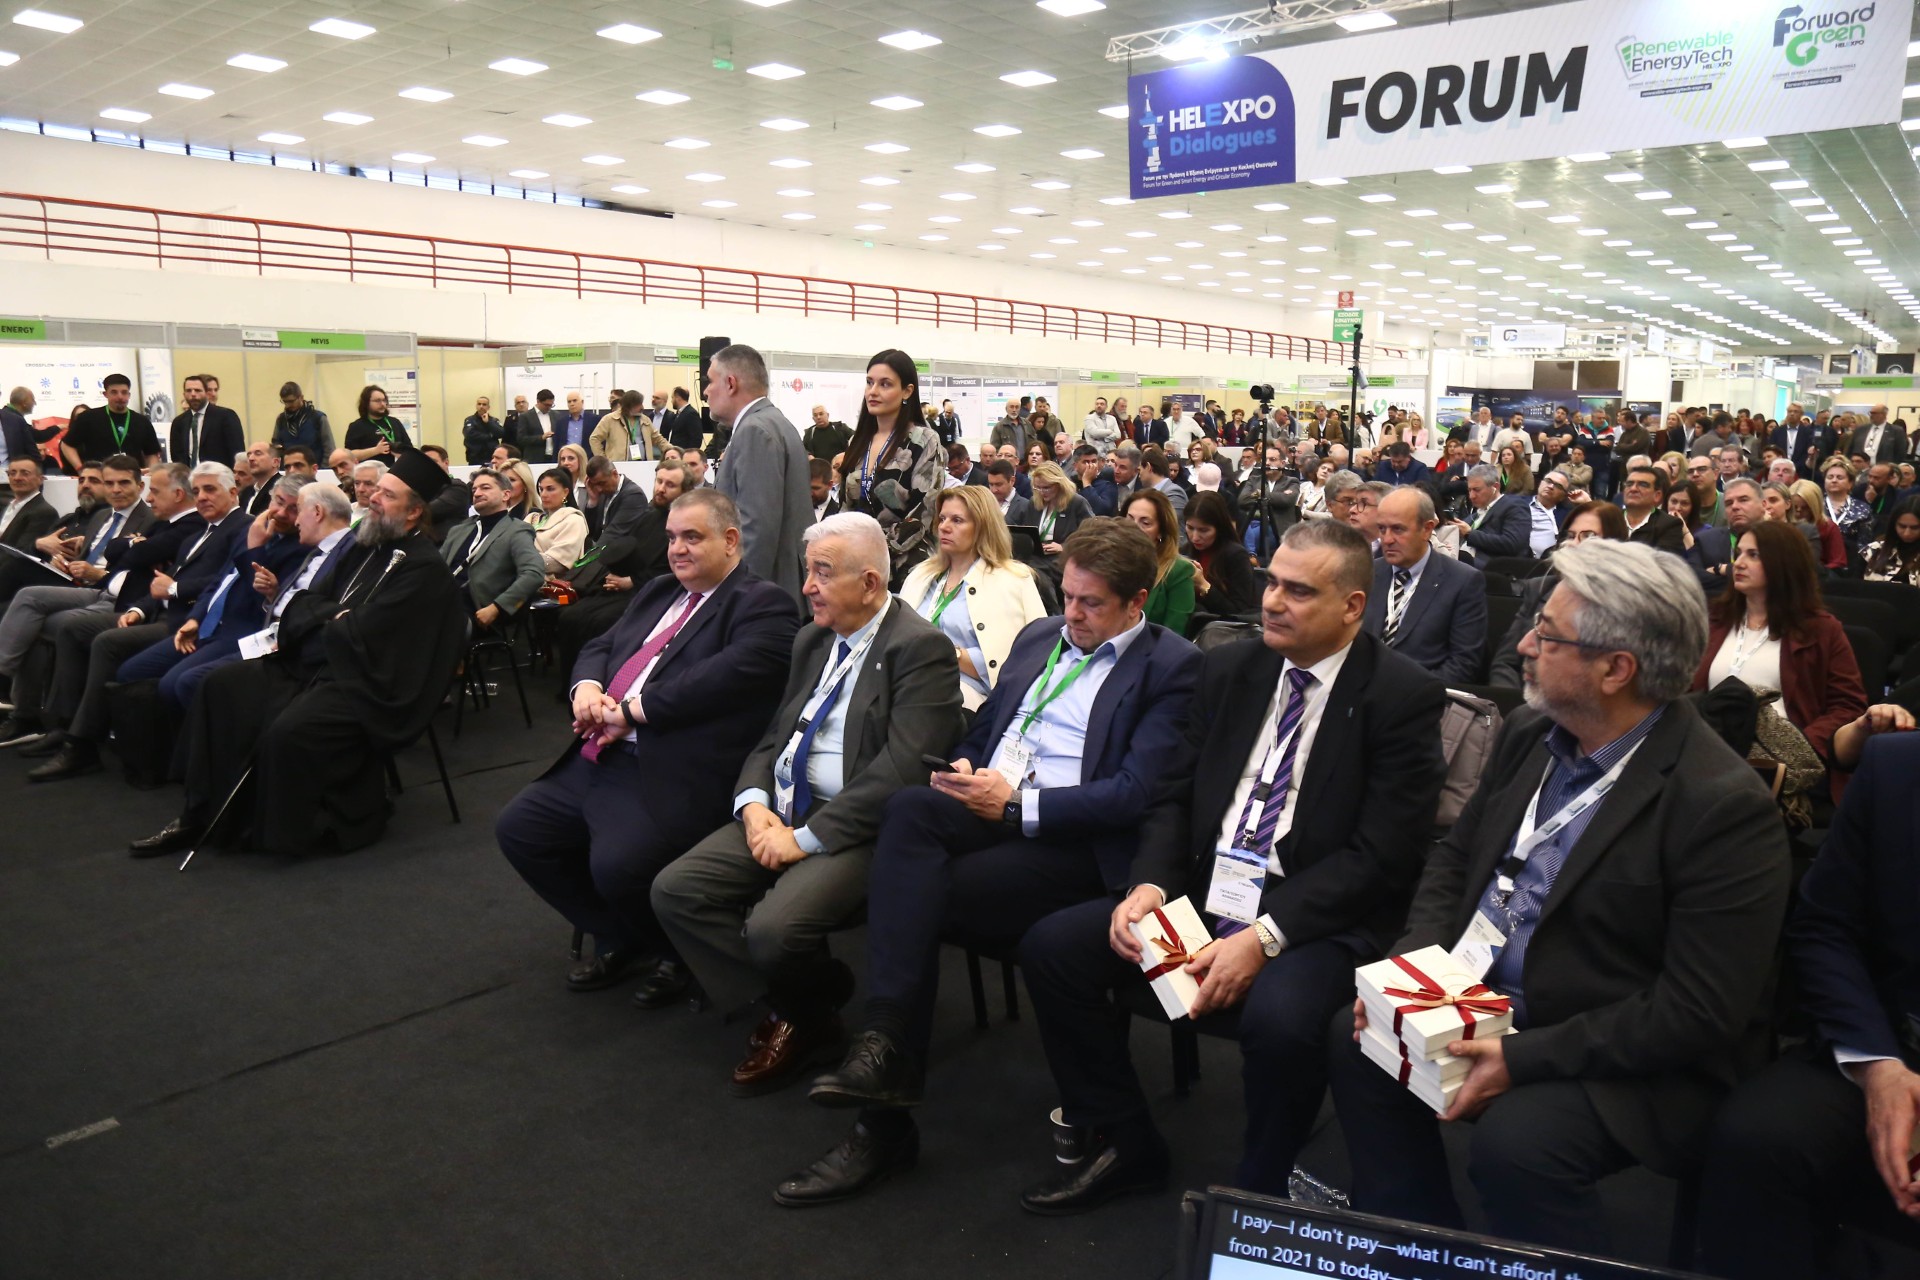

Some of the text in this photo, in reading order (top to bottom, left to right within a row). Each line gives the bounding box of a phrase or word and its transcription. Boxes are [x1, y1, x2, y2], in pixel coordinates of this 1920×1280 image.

[1773, 2, 1875, 47] Forward
[1632, 46, 1733, 72] EnergyTech
[1633, 31, 1734, 57] Renewable
[1786, 24, 1865, 67] Green
[1327, 45, 1589, 140] FORUM
[1169, 95, 1277, 132] HELEXPO
[1170, 128, 1277, 156] Dialogues
[1, 326, 35, 334] ENERGY
[1228, 1237, 1268, 1259] from
[1272, 1246, 1313, 1268] 2021
[1317, 1256, 1336, 1273] to
[1232, 1209, 1238, 1224] I
[1299, 1222, 1344, 1245] don't
[1443, 1250, 1449, 1265] I
[1453, 1257, 1498, 1274] can't
